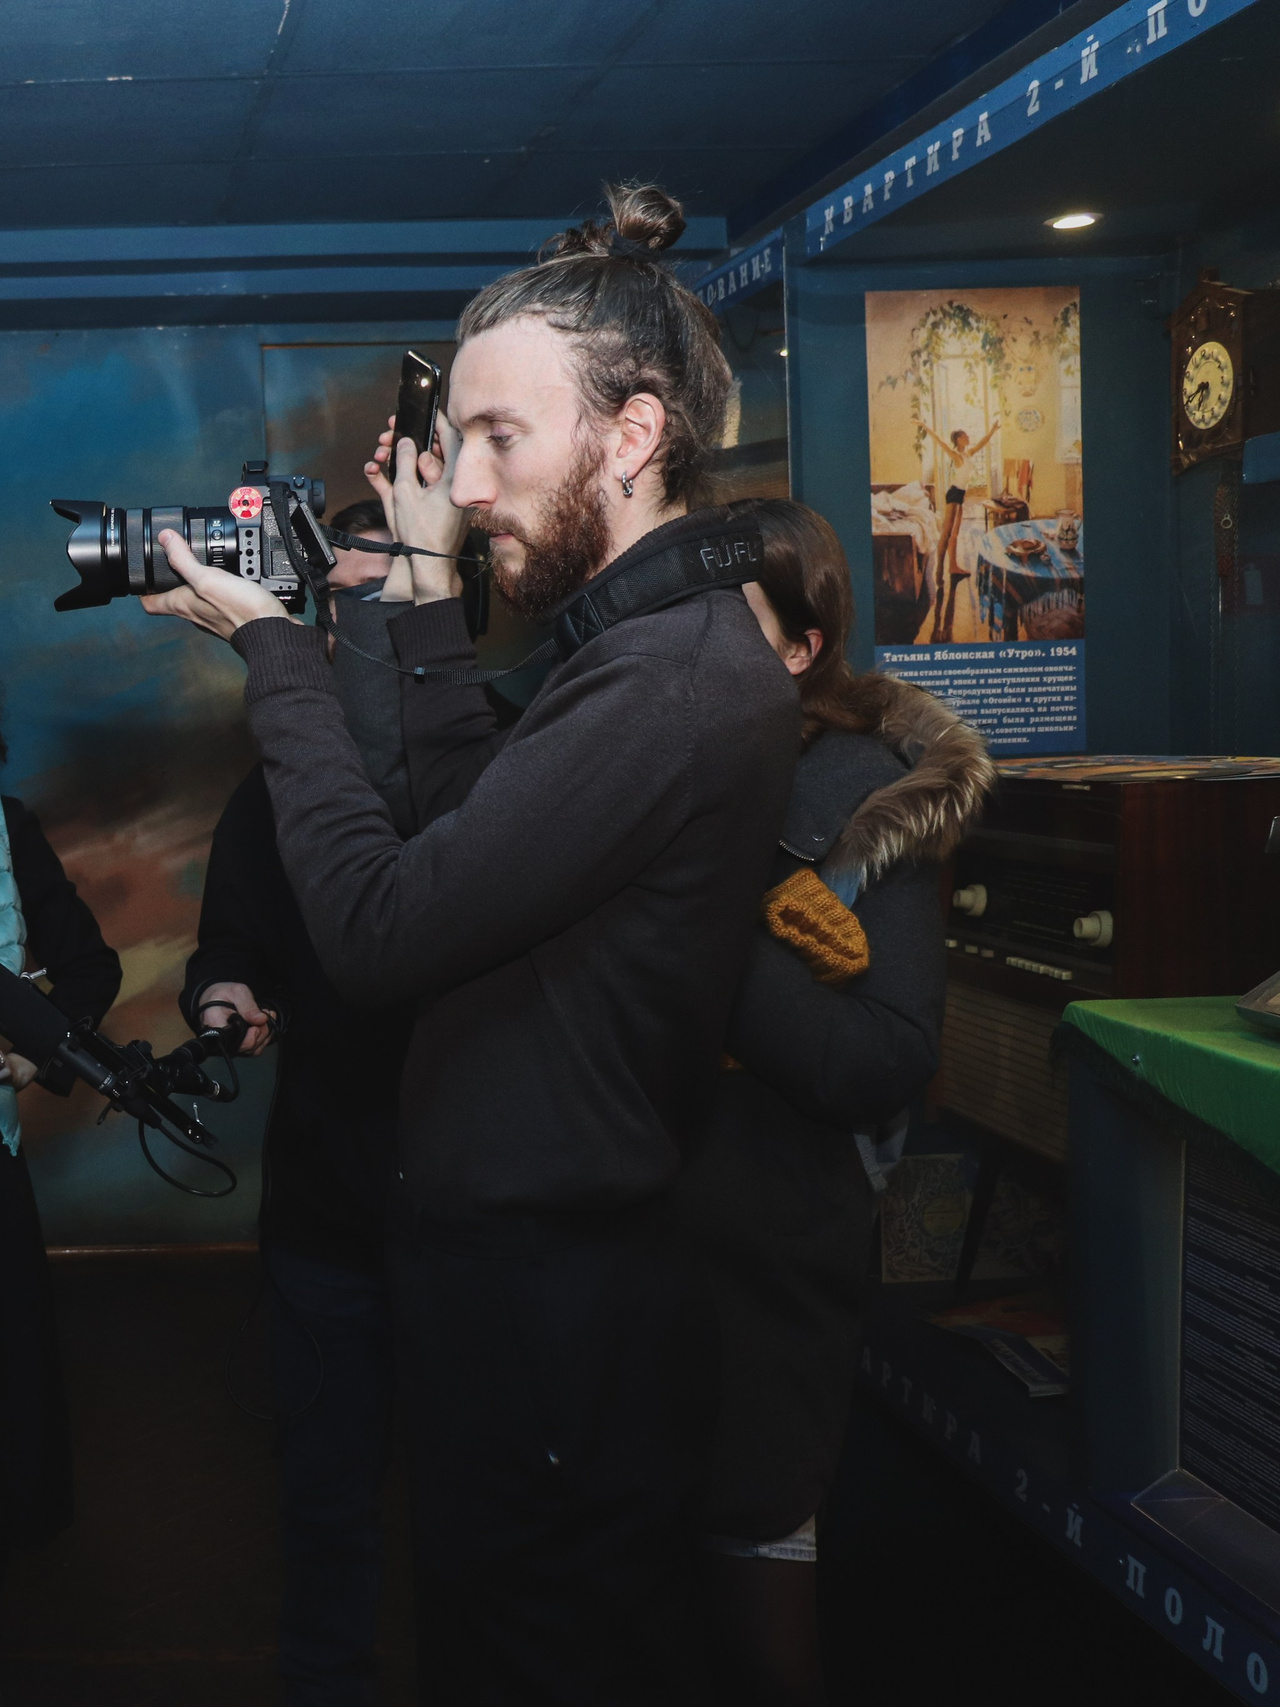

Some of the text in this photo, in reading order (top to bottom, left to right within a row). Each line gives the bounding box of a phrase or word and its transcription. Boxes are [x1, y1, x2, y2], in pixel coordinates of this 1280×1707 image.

[823, 111, 992, 236] КВАРТИРА
[883, 651, 931, 662] Татьяна
[934, 649, 995, 661] Яблонская
[1050, 646, 1077, 657] 1954
[1003, 666, 1043, 674] символом
[1004, 685, 1026, 693] были
[1028, 685, 1077, 693] напечатаны
[1033, 695, 1061, 704] других
[981, 706, 1034, 715] выпускались
[1003, 716, 1025, 724] была
[1030, 715, 1077, 724] размещена
[1125, 1554, 1269, 1694] ПОЛО
